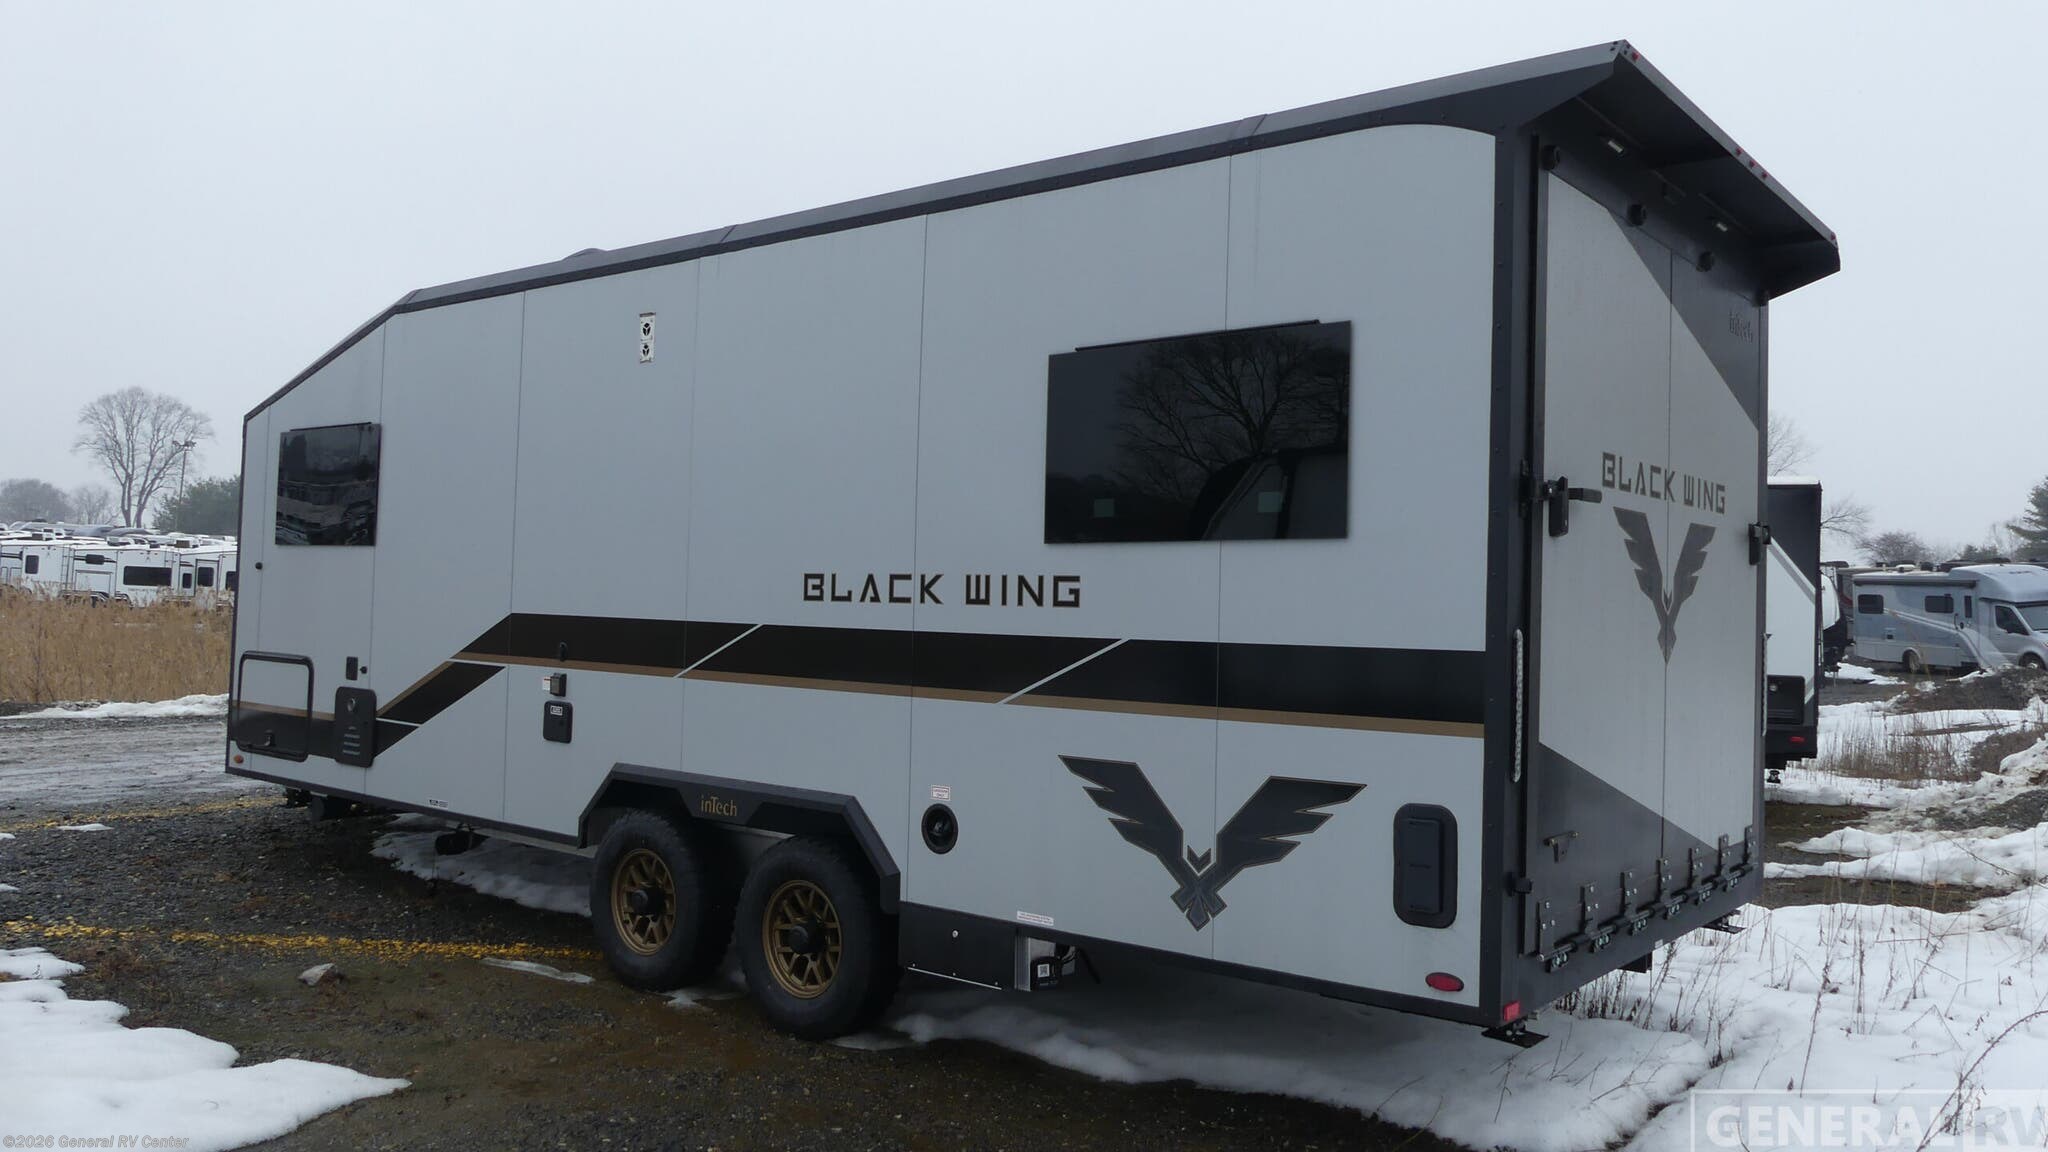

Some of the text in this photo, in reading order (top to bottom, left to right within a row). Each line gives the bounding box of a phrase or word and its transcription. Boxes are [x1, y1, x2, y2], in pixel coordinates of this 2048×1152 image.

[1602, 452, 1725, 514] BLACK WING
[803, 573, 1081, 608] BLACK WING
[701, 794, 738, 817] inTech
